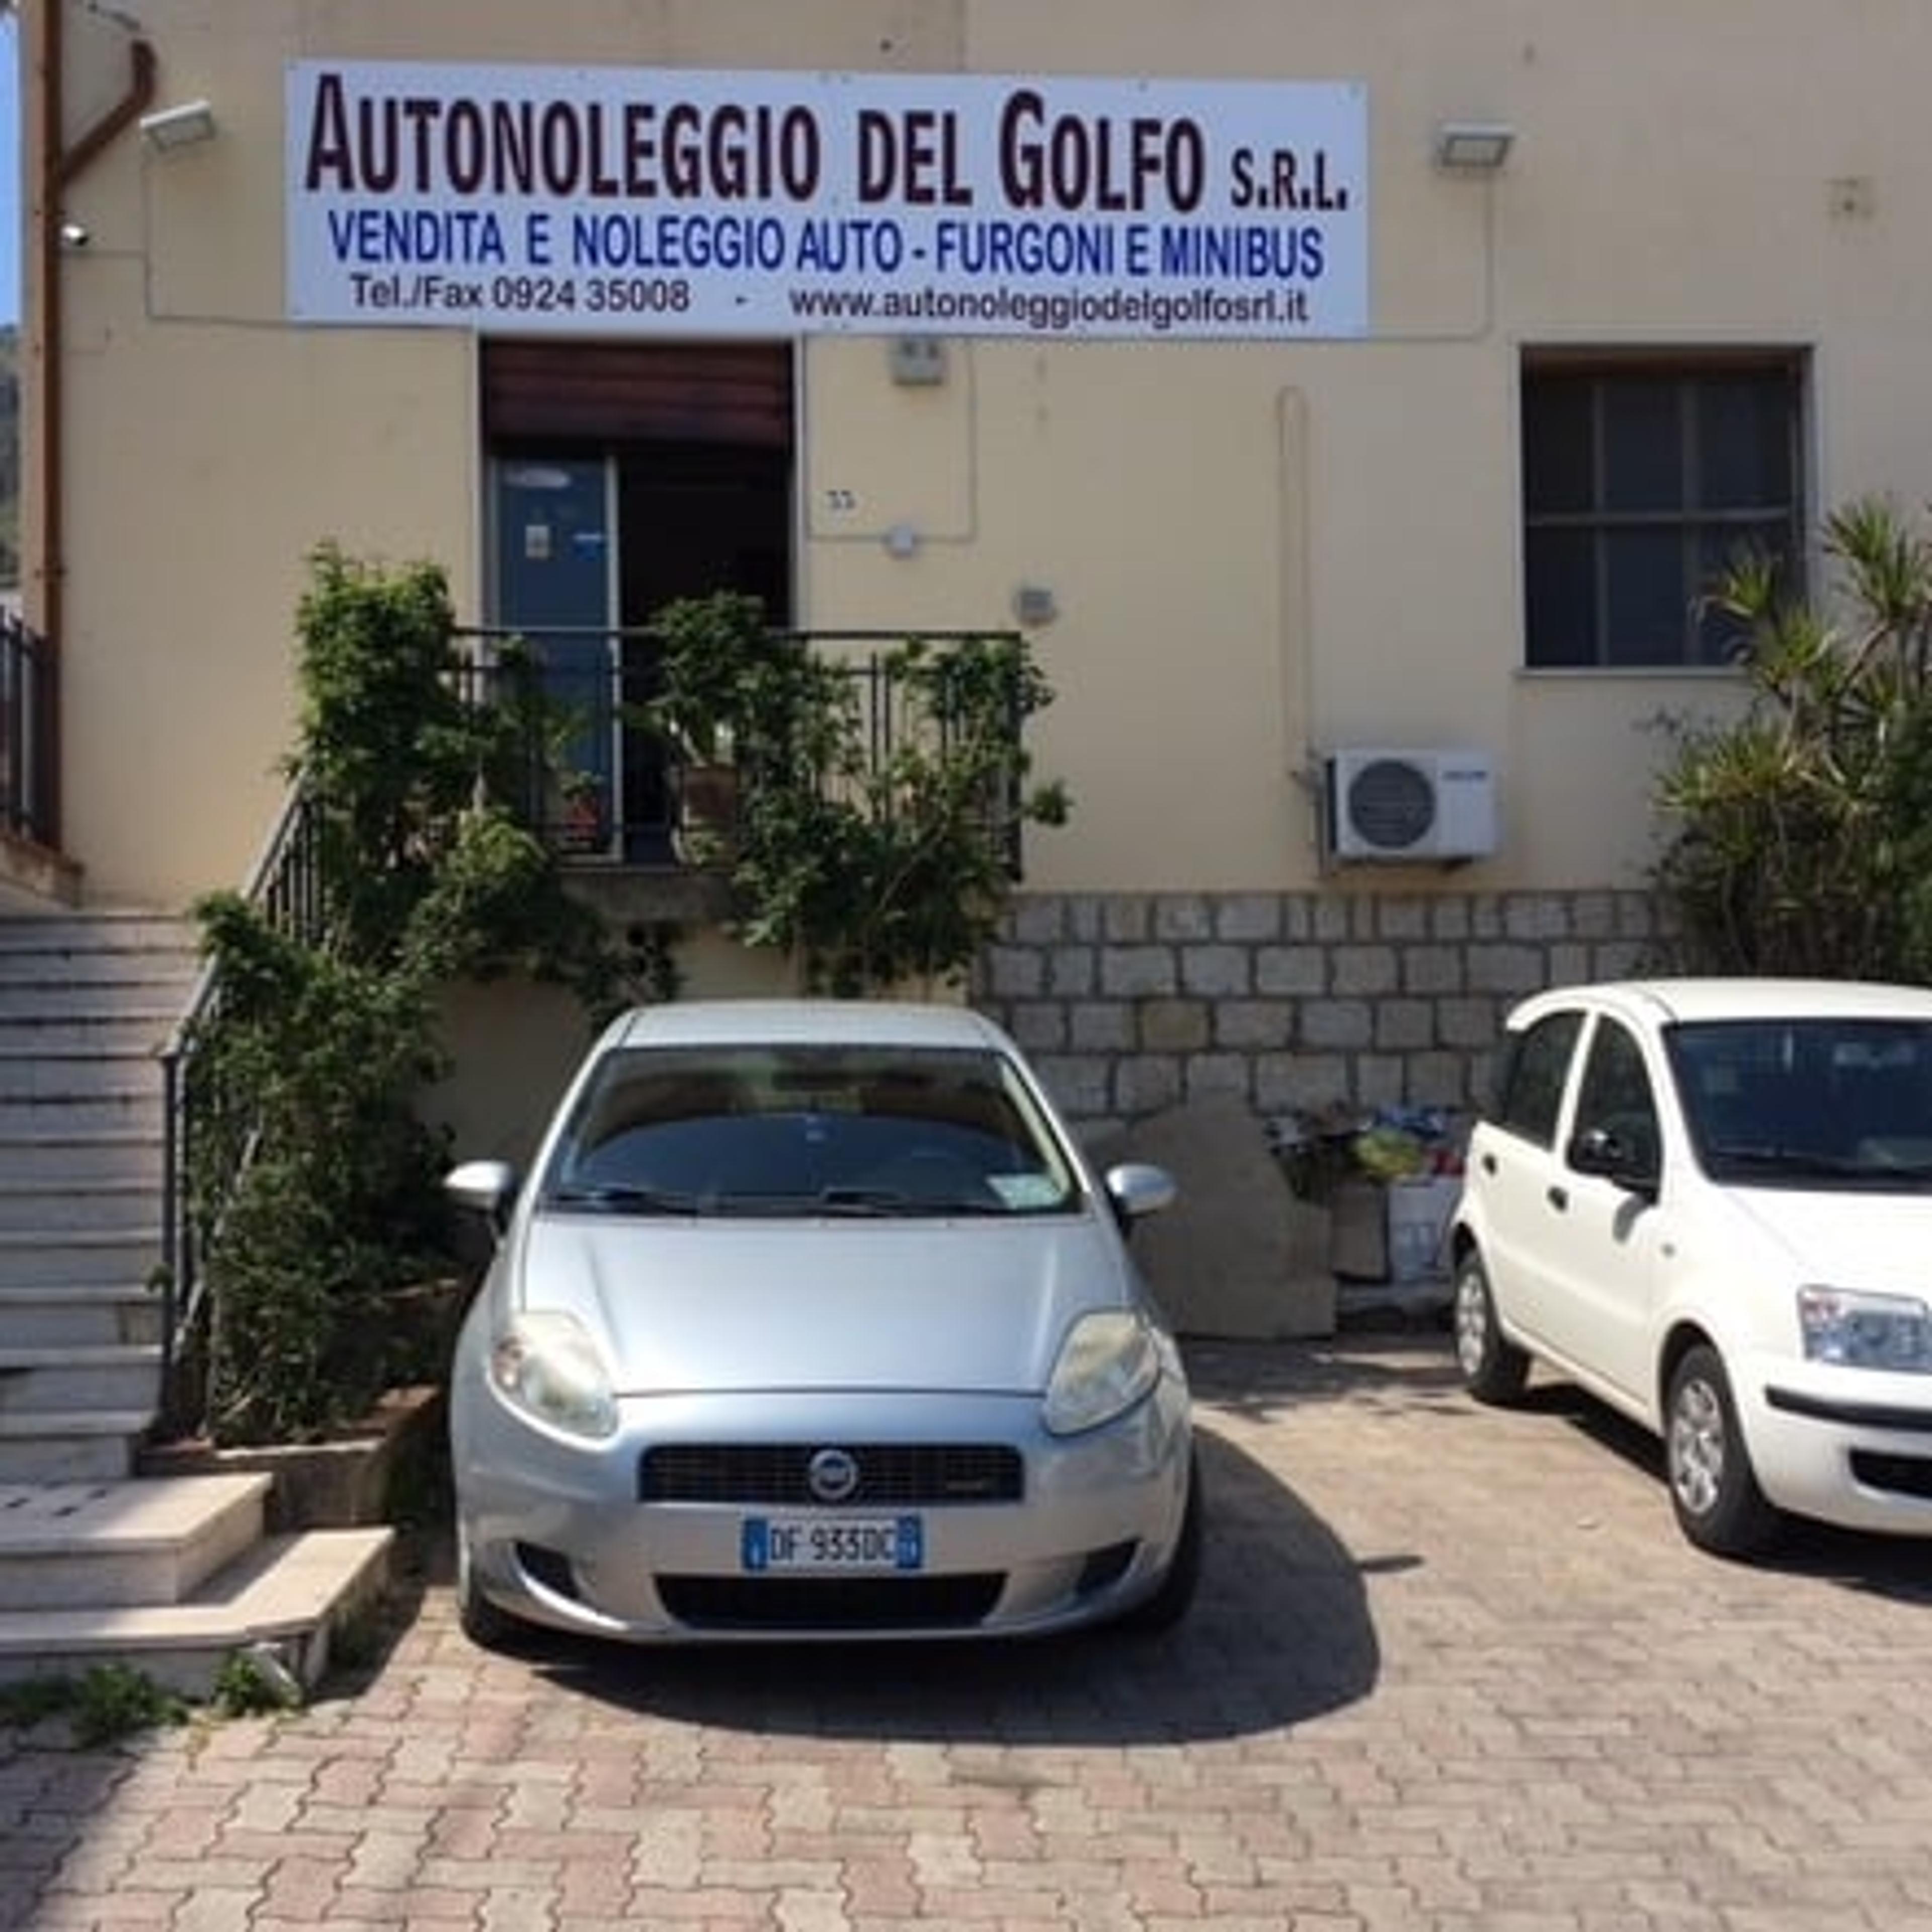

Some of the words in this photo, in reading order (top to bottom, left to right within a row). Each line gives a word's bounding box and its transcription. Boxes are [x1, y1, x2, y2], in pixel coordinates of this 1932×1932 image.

[305, 73, 820, 202] AUTONOLEGGIO
[858, 109, 973, 206] DEL
[999, 90, 1204, 213] GOLFO
[1231, 147, 1347, 211] S.R.L.
[328, 209, 505, 264] VENDITA
[527, 212, 551, 265] E
[573, 213, 786, 270] NOLEGGIO
[796, 218, 904, 274] AUTO
[937, 220, 1114, 276] FURGONI
[1126, 224, 1150, 277] E
[1161, 225, 1324, 280] MINIBUS
[349, 272, 483, 309] Tel./Fax
[492, 275, 576, 312] 0924
[586, 278, 690, 313] 35008
[789, 286, 1310, 331] www.autonoleggiodelgolfosrl.it
